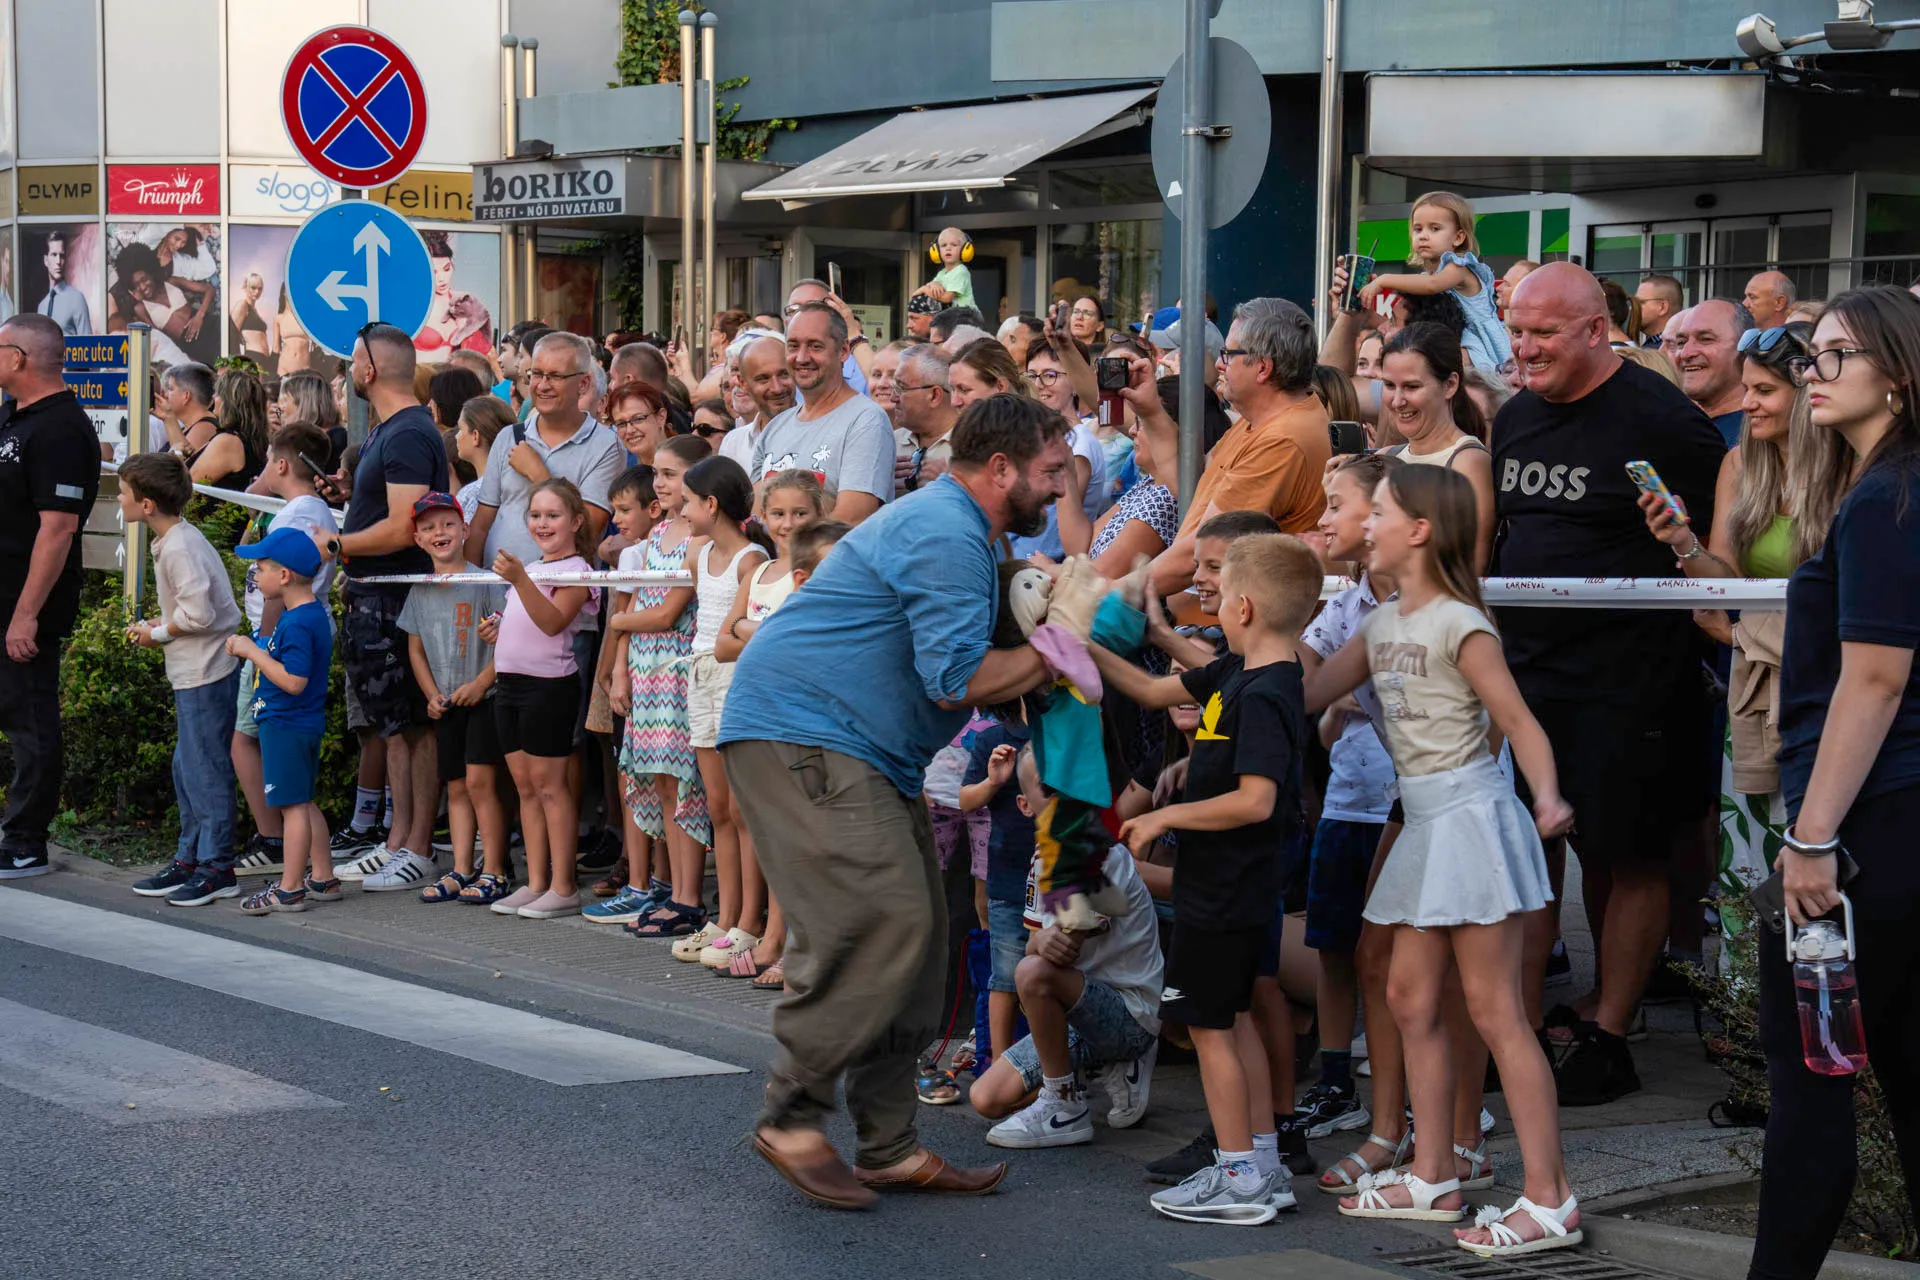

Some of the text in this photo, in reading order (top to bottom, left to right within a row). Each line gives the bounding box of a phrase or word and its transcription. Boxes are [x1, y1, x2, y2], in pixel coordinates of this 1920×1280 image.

[28, 183, 92, 199] OLYMP
[124, 177, 204, 214] Triumph
[482, 206, 516, 219] FÉRFI
[551, 199, 615, 216] DIVATÁRU
[63, 342, 113, 362] renc utca
[80, 379, 103, 399] utca
[1501, 458, 1591, 501] BOSS
